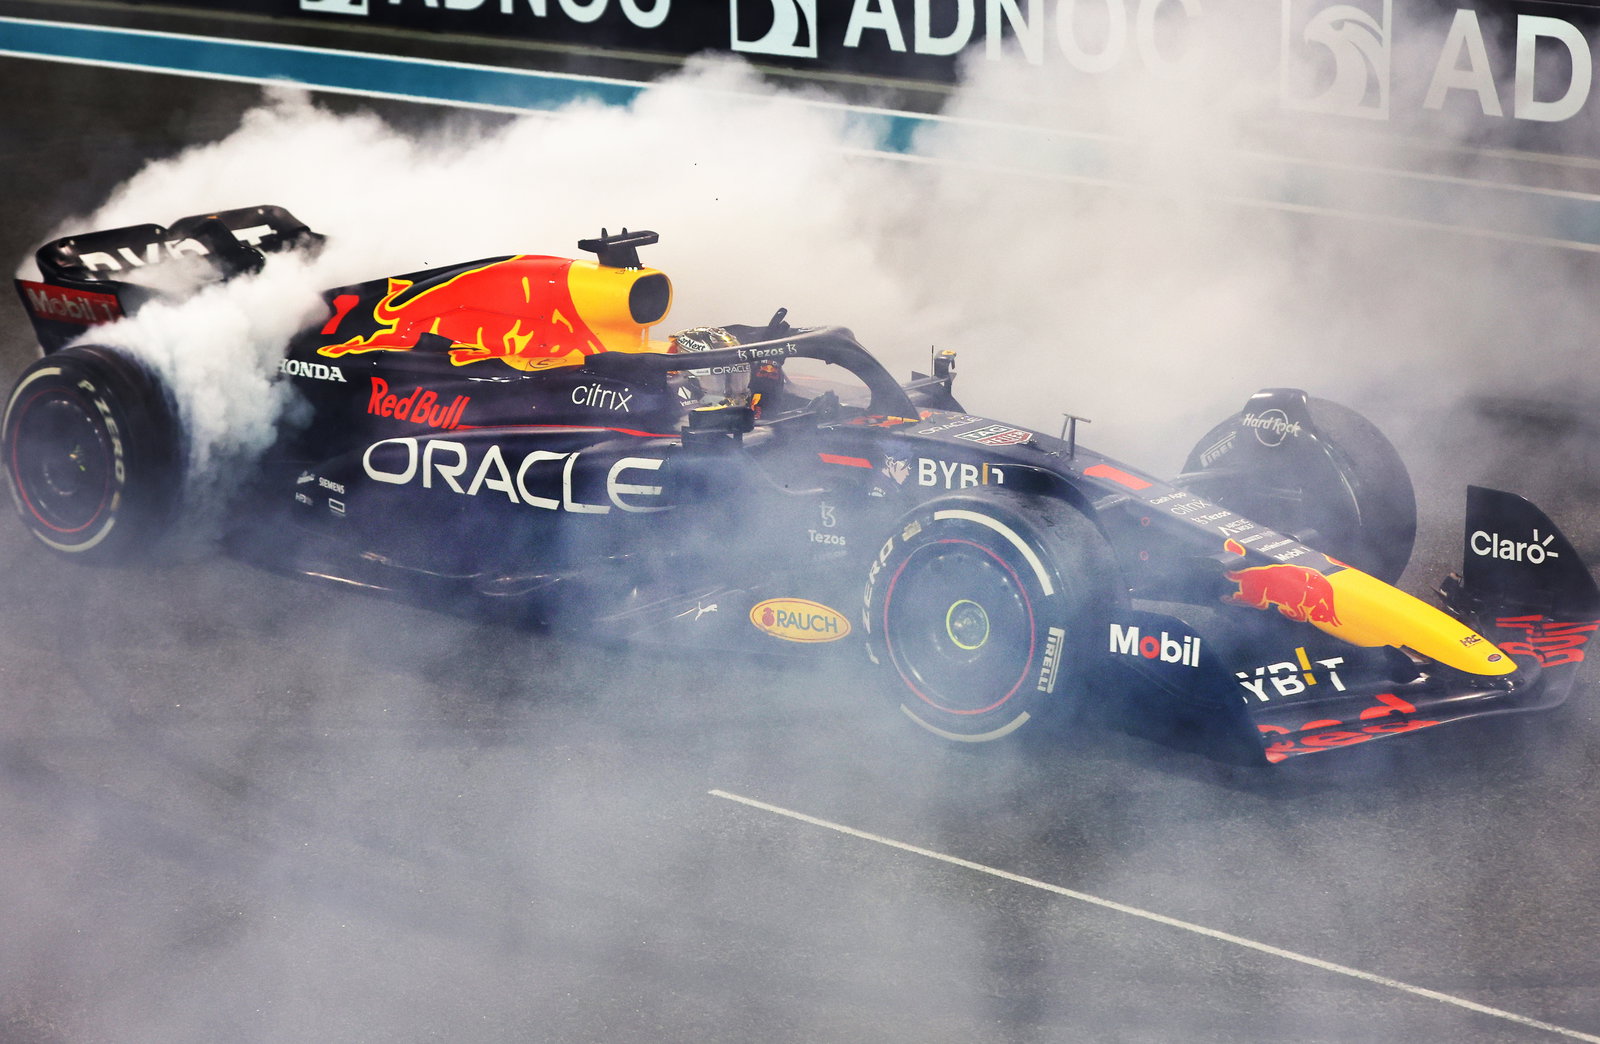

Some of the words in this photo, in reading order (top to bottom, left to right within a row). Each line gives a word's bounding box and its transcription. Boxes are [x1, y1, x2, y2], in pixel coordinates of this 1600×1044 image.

[1423, 9, 1593, 122] AD
[25, 288, 97, 321] Mobil
[749, 347, 785, 359] Tezos
[572, 383, 633, 412] citrix
[961, 426, 1007, 439] TAG
[1243, 413, 1273, 430] Hard
[1273, 416, 1302, 437] Rock
[363, 437, 680, 514] ORACLE
[808, 529, 846, 545] Tezos
[1471, 529, 1559, 564] Claro
[777, 609, 838, 633] RAUCH
[1037, 627, 1065, 694] PIRELLI
[1109, 624, 1200, 667] Mobil
